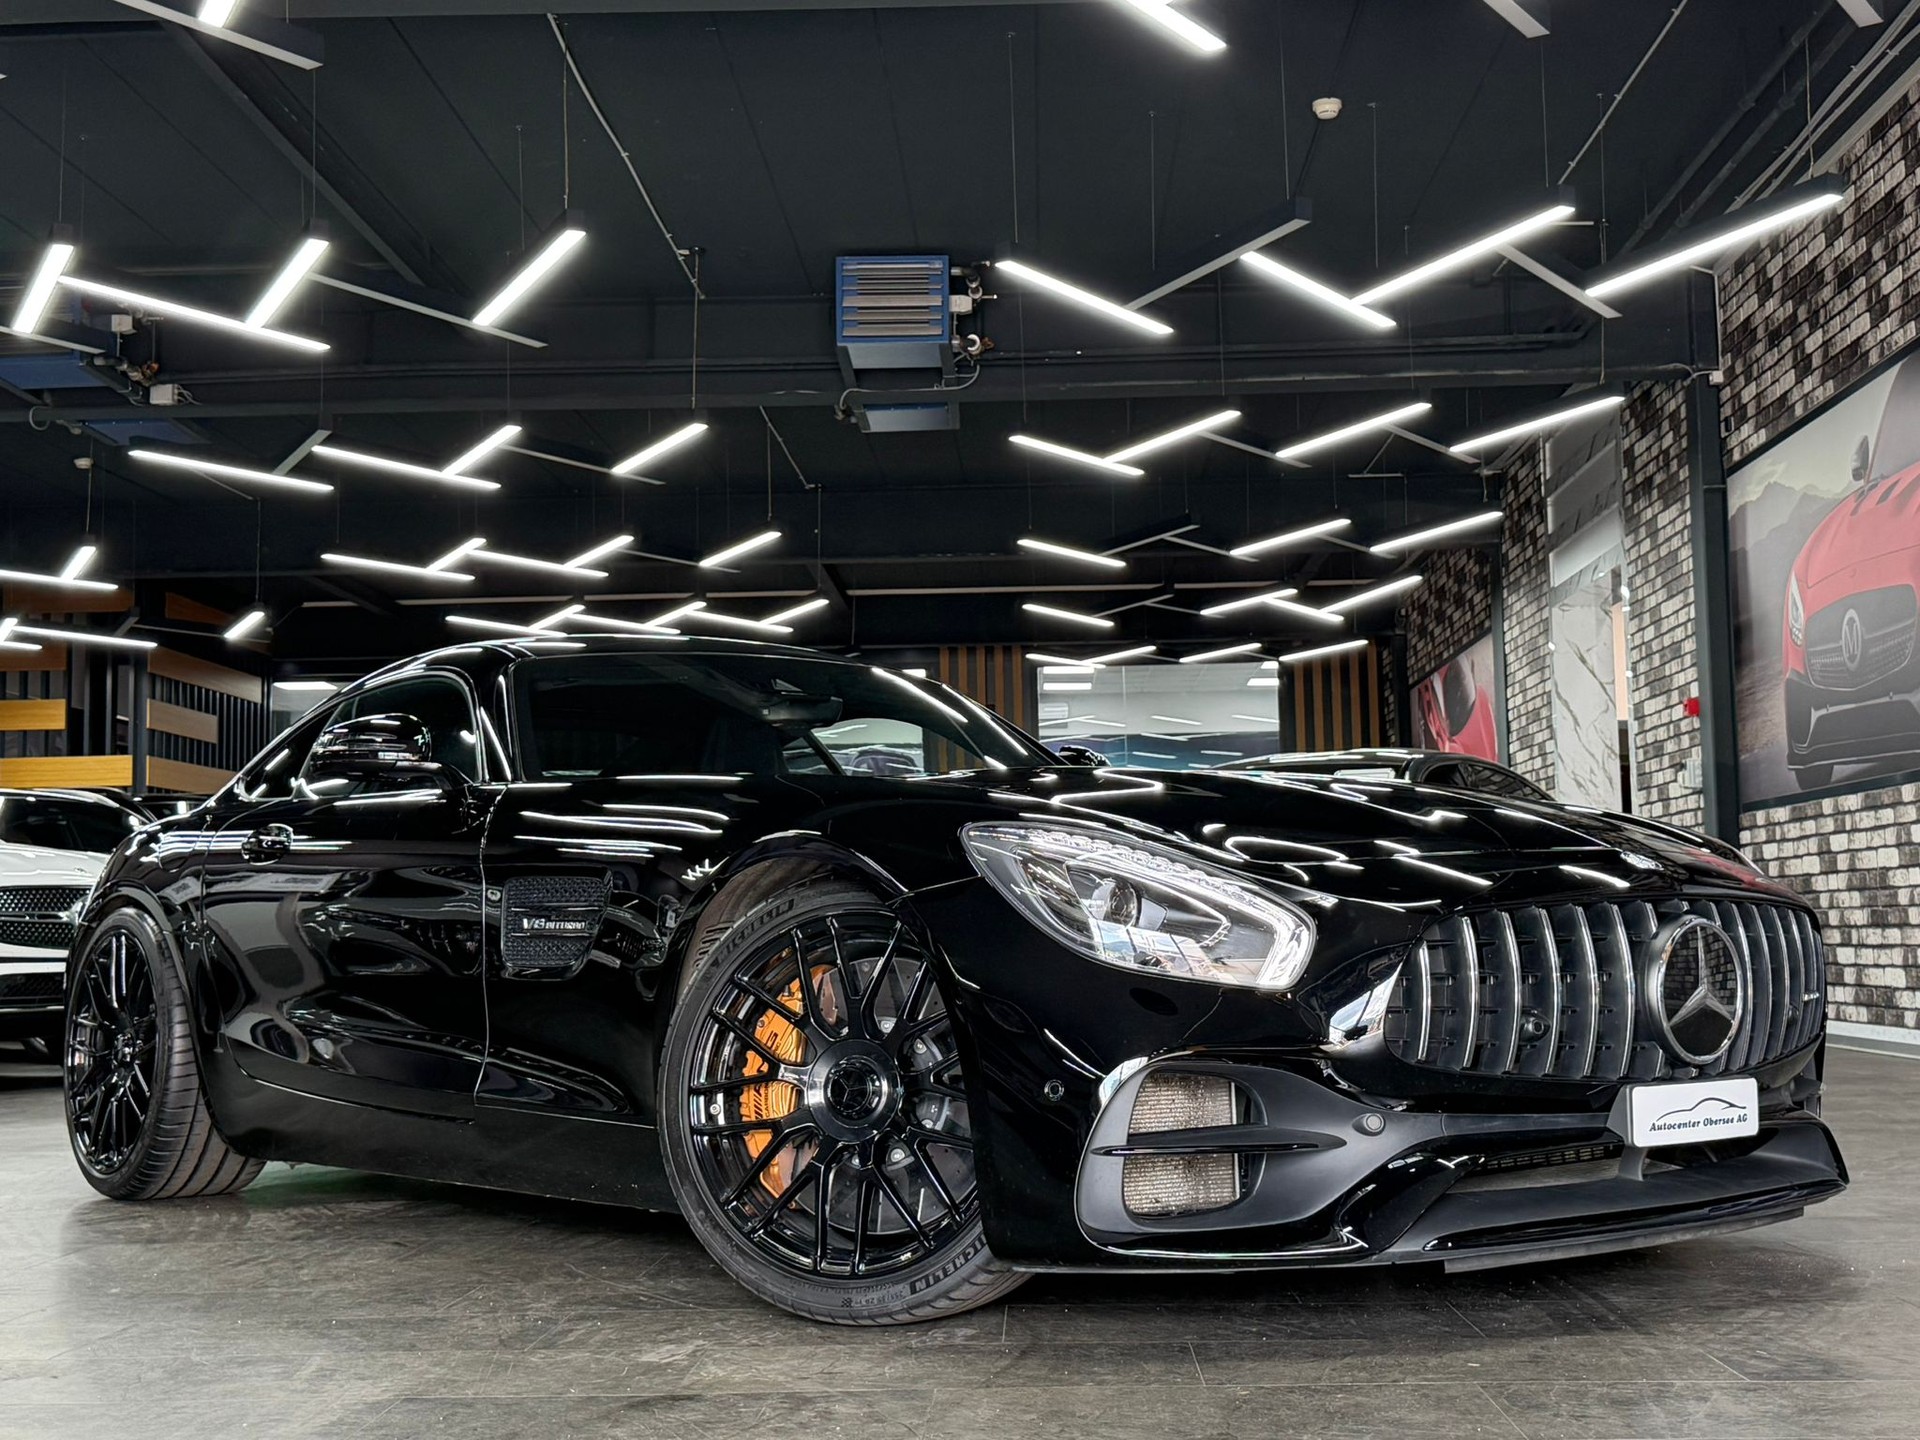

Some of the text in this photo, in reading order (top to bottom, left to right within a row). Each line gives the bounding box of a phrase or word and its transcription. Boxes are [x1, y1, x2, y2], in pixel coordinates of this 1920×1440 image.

[1649, 1113, 1748, 1132] Autocenter Obersee AG
